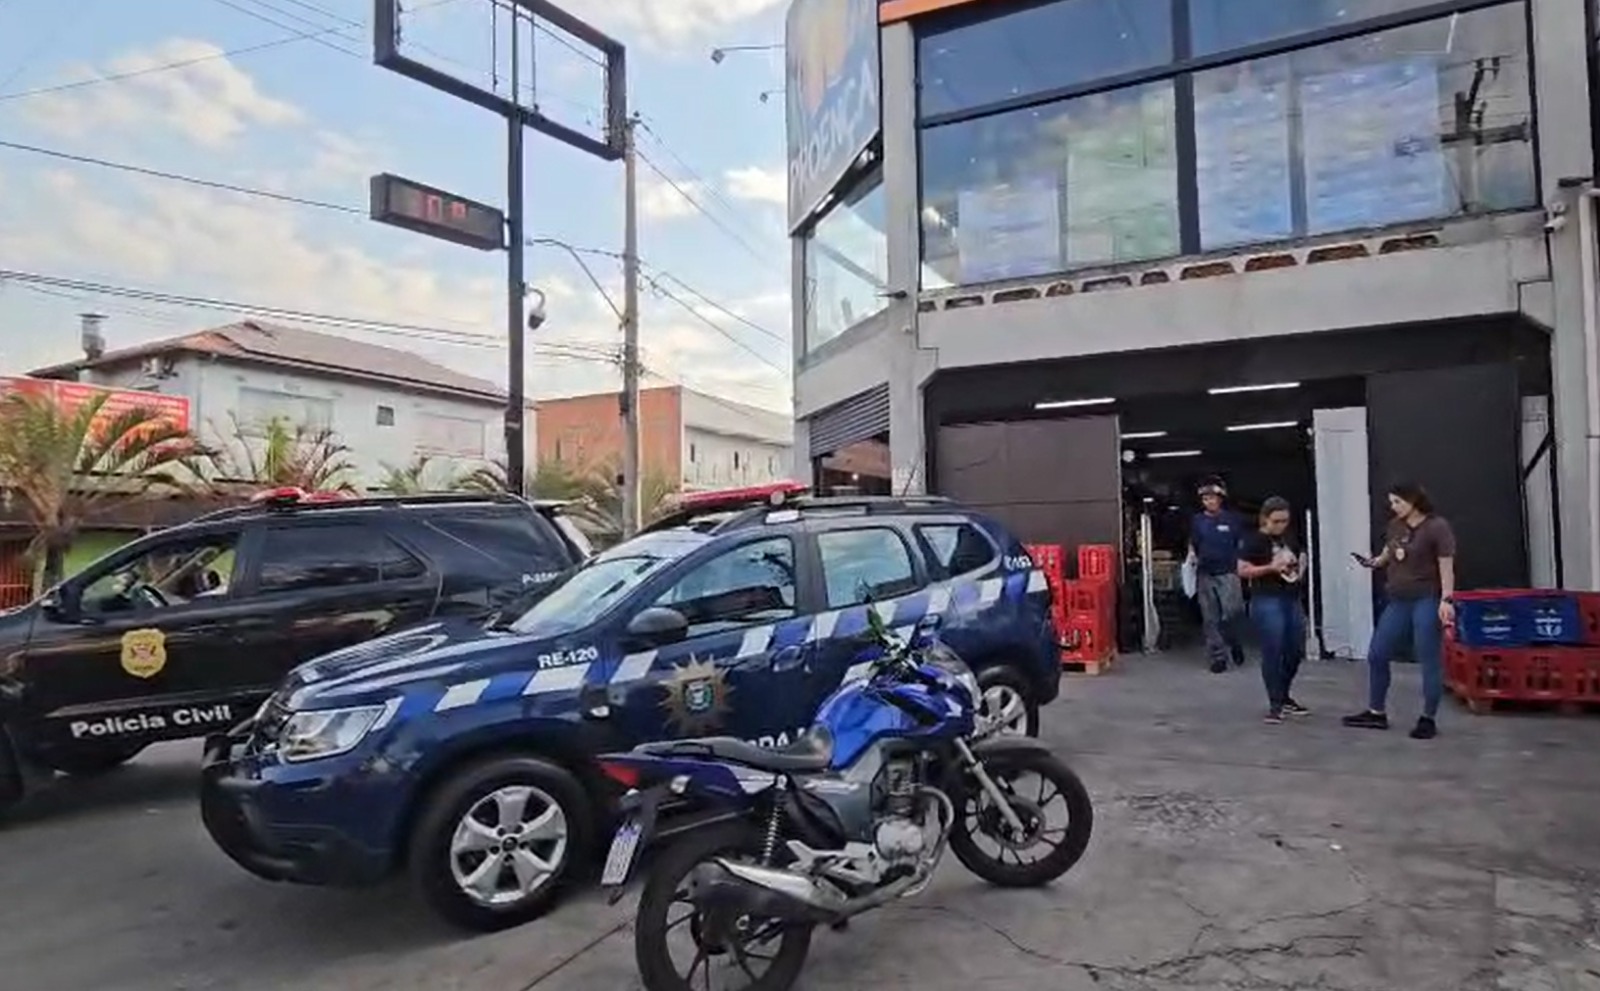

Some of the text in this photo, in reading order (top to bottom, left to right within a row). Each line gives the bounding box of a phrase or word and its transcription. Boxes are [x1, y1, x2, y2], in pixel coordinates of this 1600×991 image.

[789, 58, 877, 218] PROENÇA
[538, 646, 599, 668] RE-120
[173, 704, 232, 726] Civil
